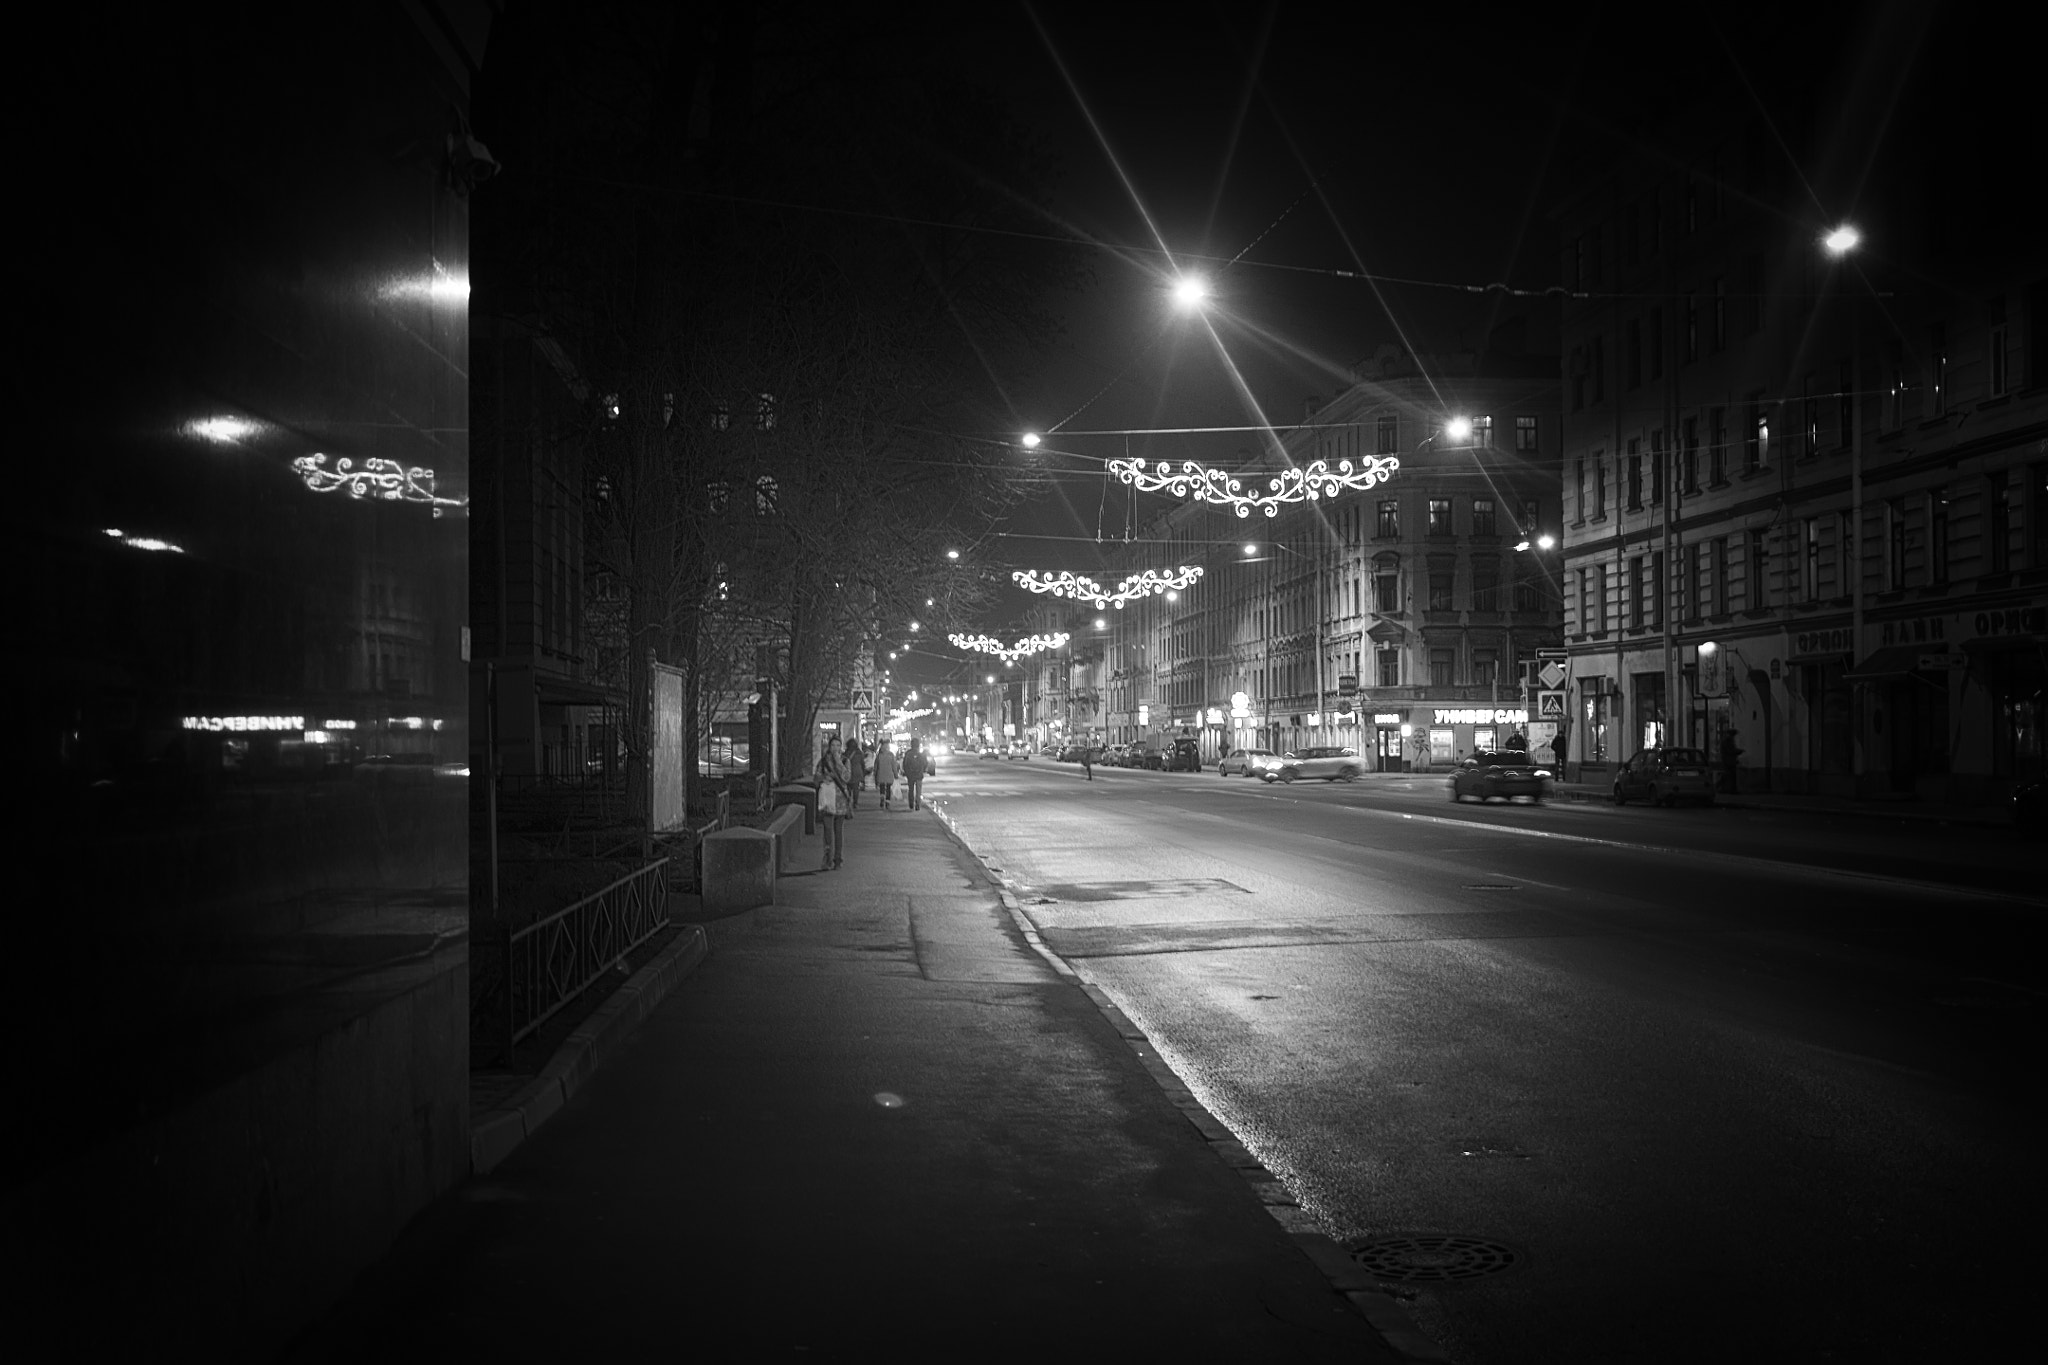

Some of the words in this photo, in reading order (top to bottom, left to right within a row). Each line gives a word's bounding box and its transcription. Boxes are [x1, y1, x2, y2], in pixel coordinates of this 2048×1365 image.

[1882, 616, 1944, 645] ЛАЙН
[1975, 607, 2046, 635] ОРИО
[1434, 709, 1528, 724] УНИВЕРСАМ
